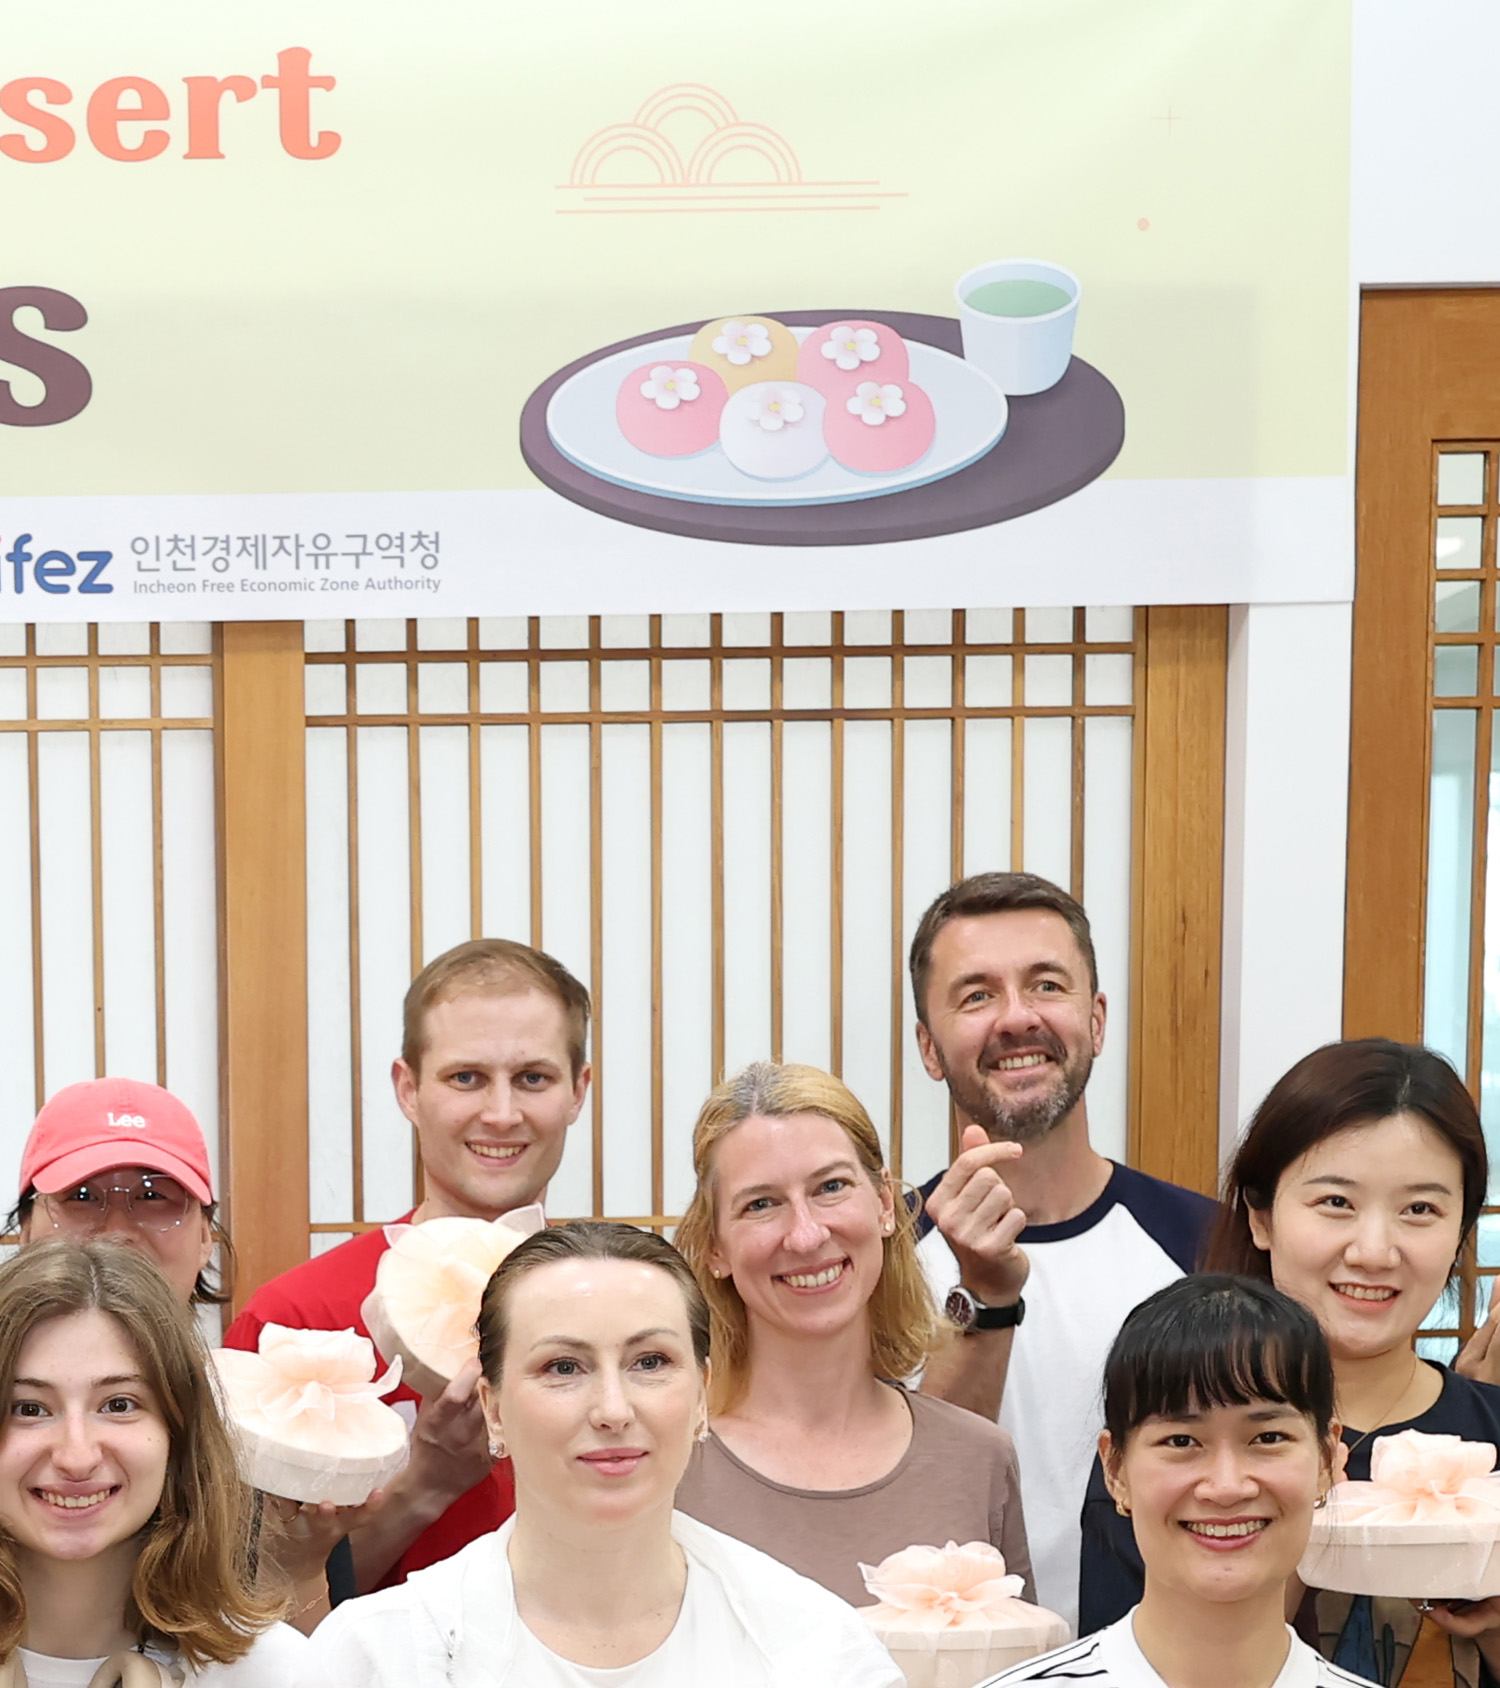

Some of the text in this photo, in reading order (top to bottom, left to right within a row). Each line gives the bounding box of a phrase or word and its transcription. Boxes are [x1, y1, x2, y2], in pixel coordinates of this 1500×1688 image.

[129, 530, 442, 574] 인천경제자유구역청
[132, 575, 443, 596] Incheon Free Economic Zone Authority
[107, 1112, 147, 1129] Lee
